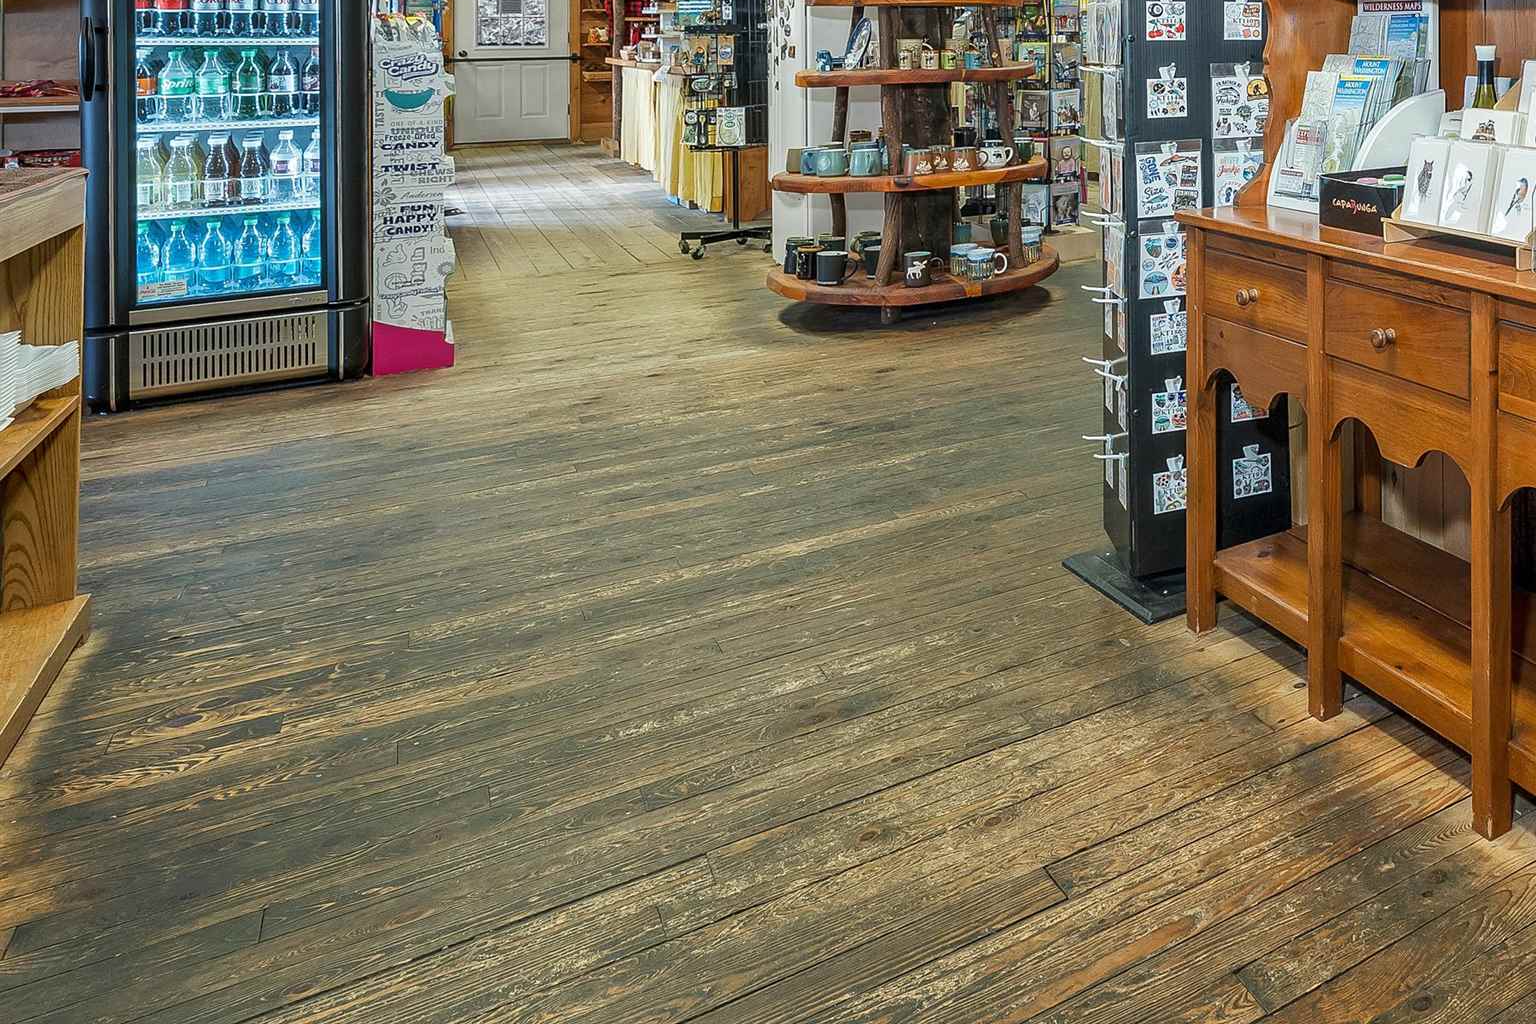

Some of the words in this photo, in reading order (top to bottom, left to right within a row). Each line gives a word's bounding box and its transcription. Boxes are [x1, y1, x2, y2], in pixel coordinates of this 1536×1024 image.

[1363, 2, 1403, 12] WILDERNESS
[1404, 1, 1422, 11] MAPS
[380, 53, 427, 70] Crazy
[387, 60, 439, 78] Candy
[375, 100, 385, 128] TASTY
[380, 141, 439, 151] CANDY
[381, 162, 440, 173] TWIST
[400, 204, 435, 213] FUN
[386, 224, 434, 236] CANDY!
